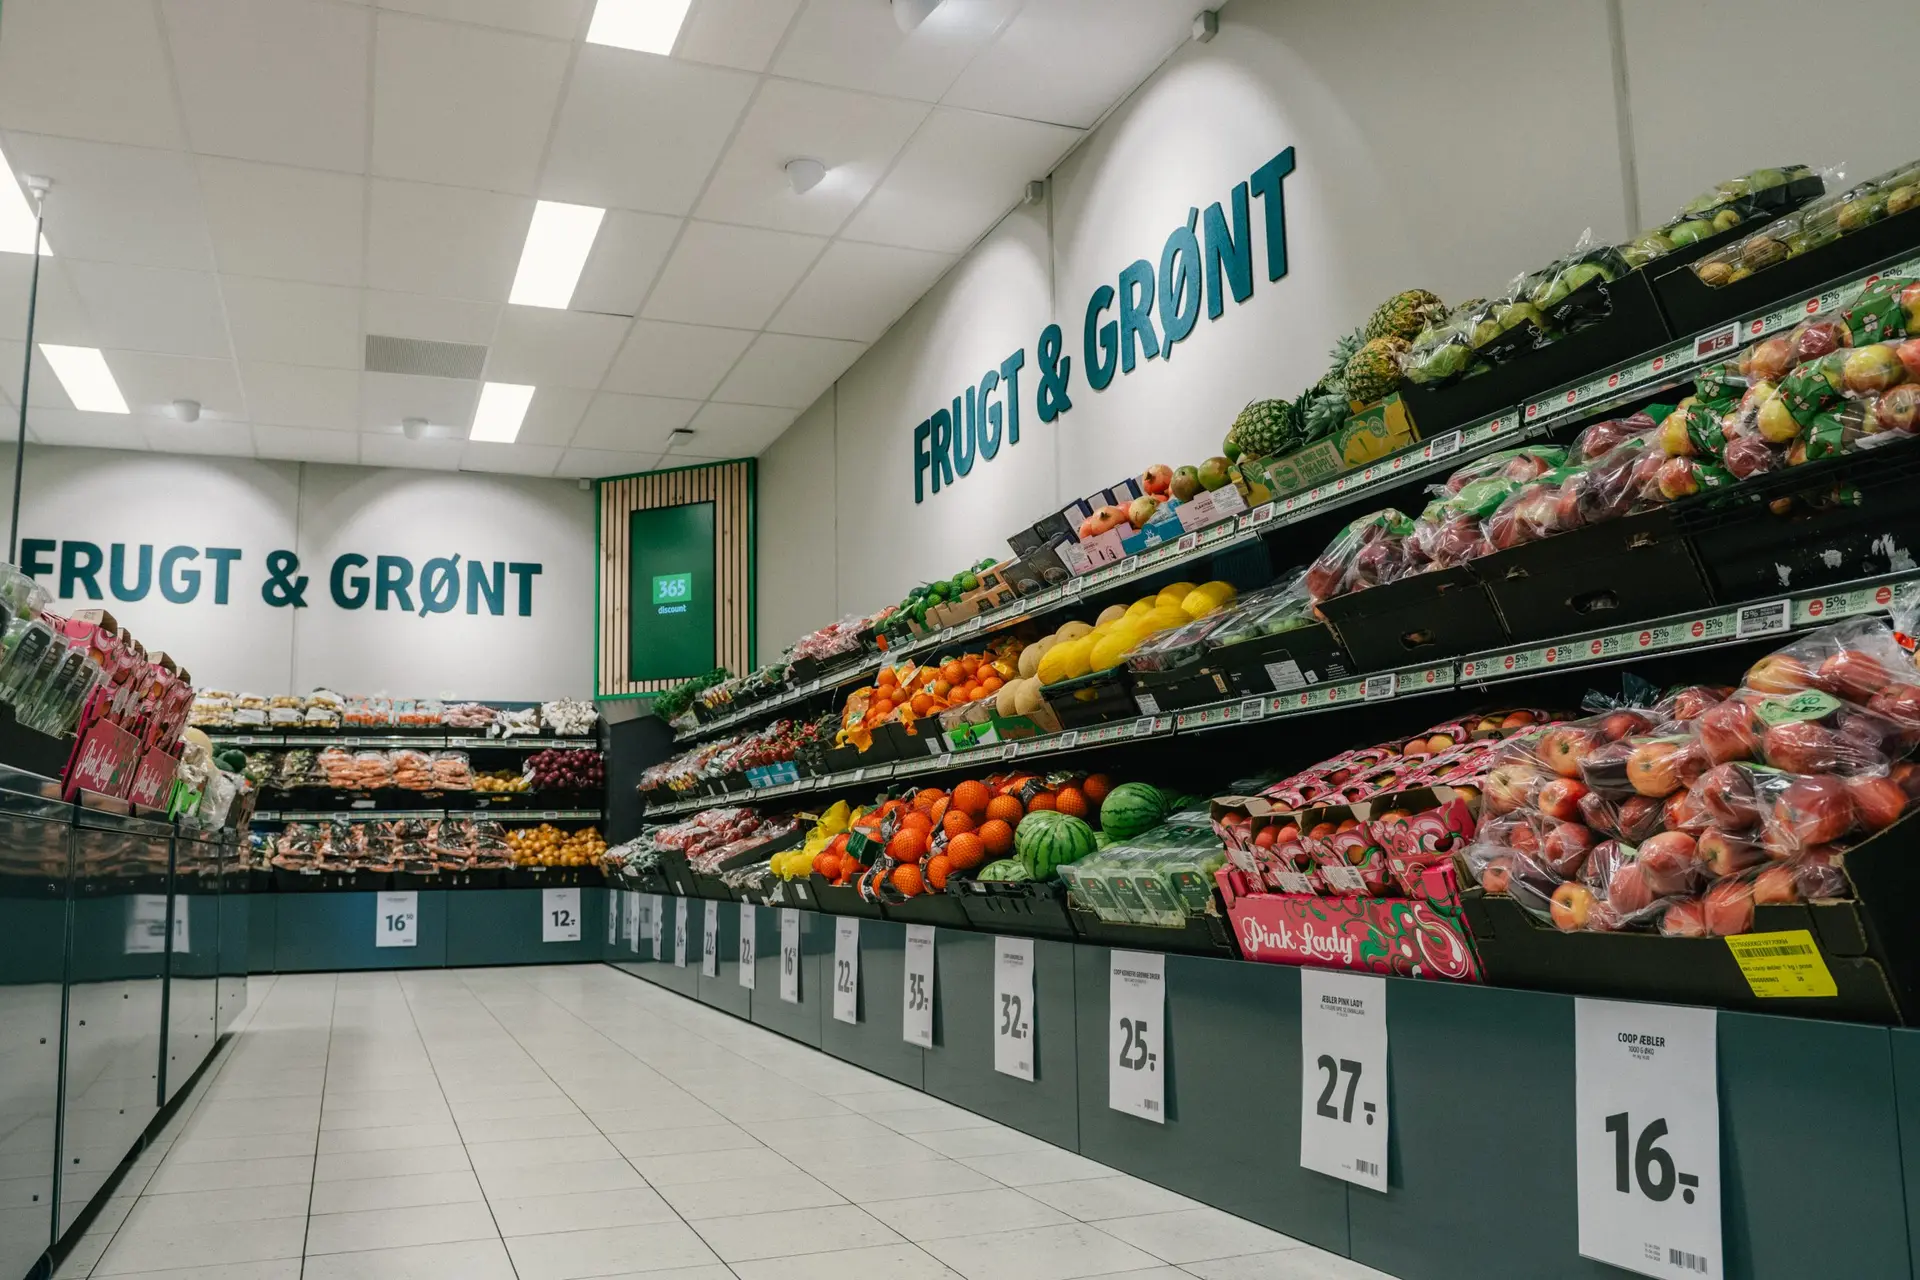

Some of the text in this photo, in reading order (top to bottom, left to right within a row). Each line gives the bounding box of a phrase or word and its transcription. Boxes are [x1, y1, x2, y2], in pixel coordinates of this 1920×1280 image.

[1821, 291, 1840, 304] 5%
[914, 145, 1296, 504] FRUGT & GRØNT
[1765, 313, 1783, 326] 5%
[1665, 351, 1680, 363] 5%
[1619, 368, 1634, 380] 5%
[1577, 386, 1591, 396] 5%
[1537, 401, 1550, 411] 5%
[1500, 416, 1512, 426] 5%
[20, 538, 543, 617] FRUGT & GRØNT
[658, 578, 686, 598] 365
[1826, 594, 1847, 609] 5%
[657, 604, 687, 614] discount
[1706, 618, 1723, 631] 5%
[1653, 628, 1669, 640] 5%
[1603, 637, 1618, 649] 5%
[1558, 645, 1572, 656] 5%
[1515, 653, 1528, 664] 5%
[1475, 661, 1488, 671] 5%
[1401, 674, 1412, 684] 5%
[1436, 668, 1447, 679] 5%
[385, 914, 406, 931] 16
[1242, 917, 1352, 964] Pink Lady
[1322, 995, 1363, 1008] ÆBLER PINK LADY
[1618, 1032, 1666, 1047] COOP ÆBLER
[1628, 1046, 1639, 1054] 1000
